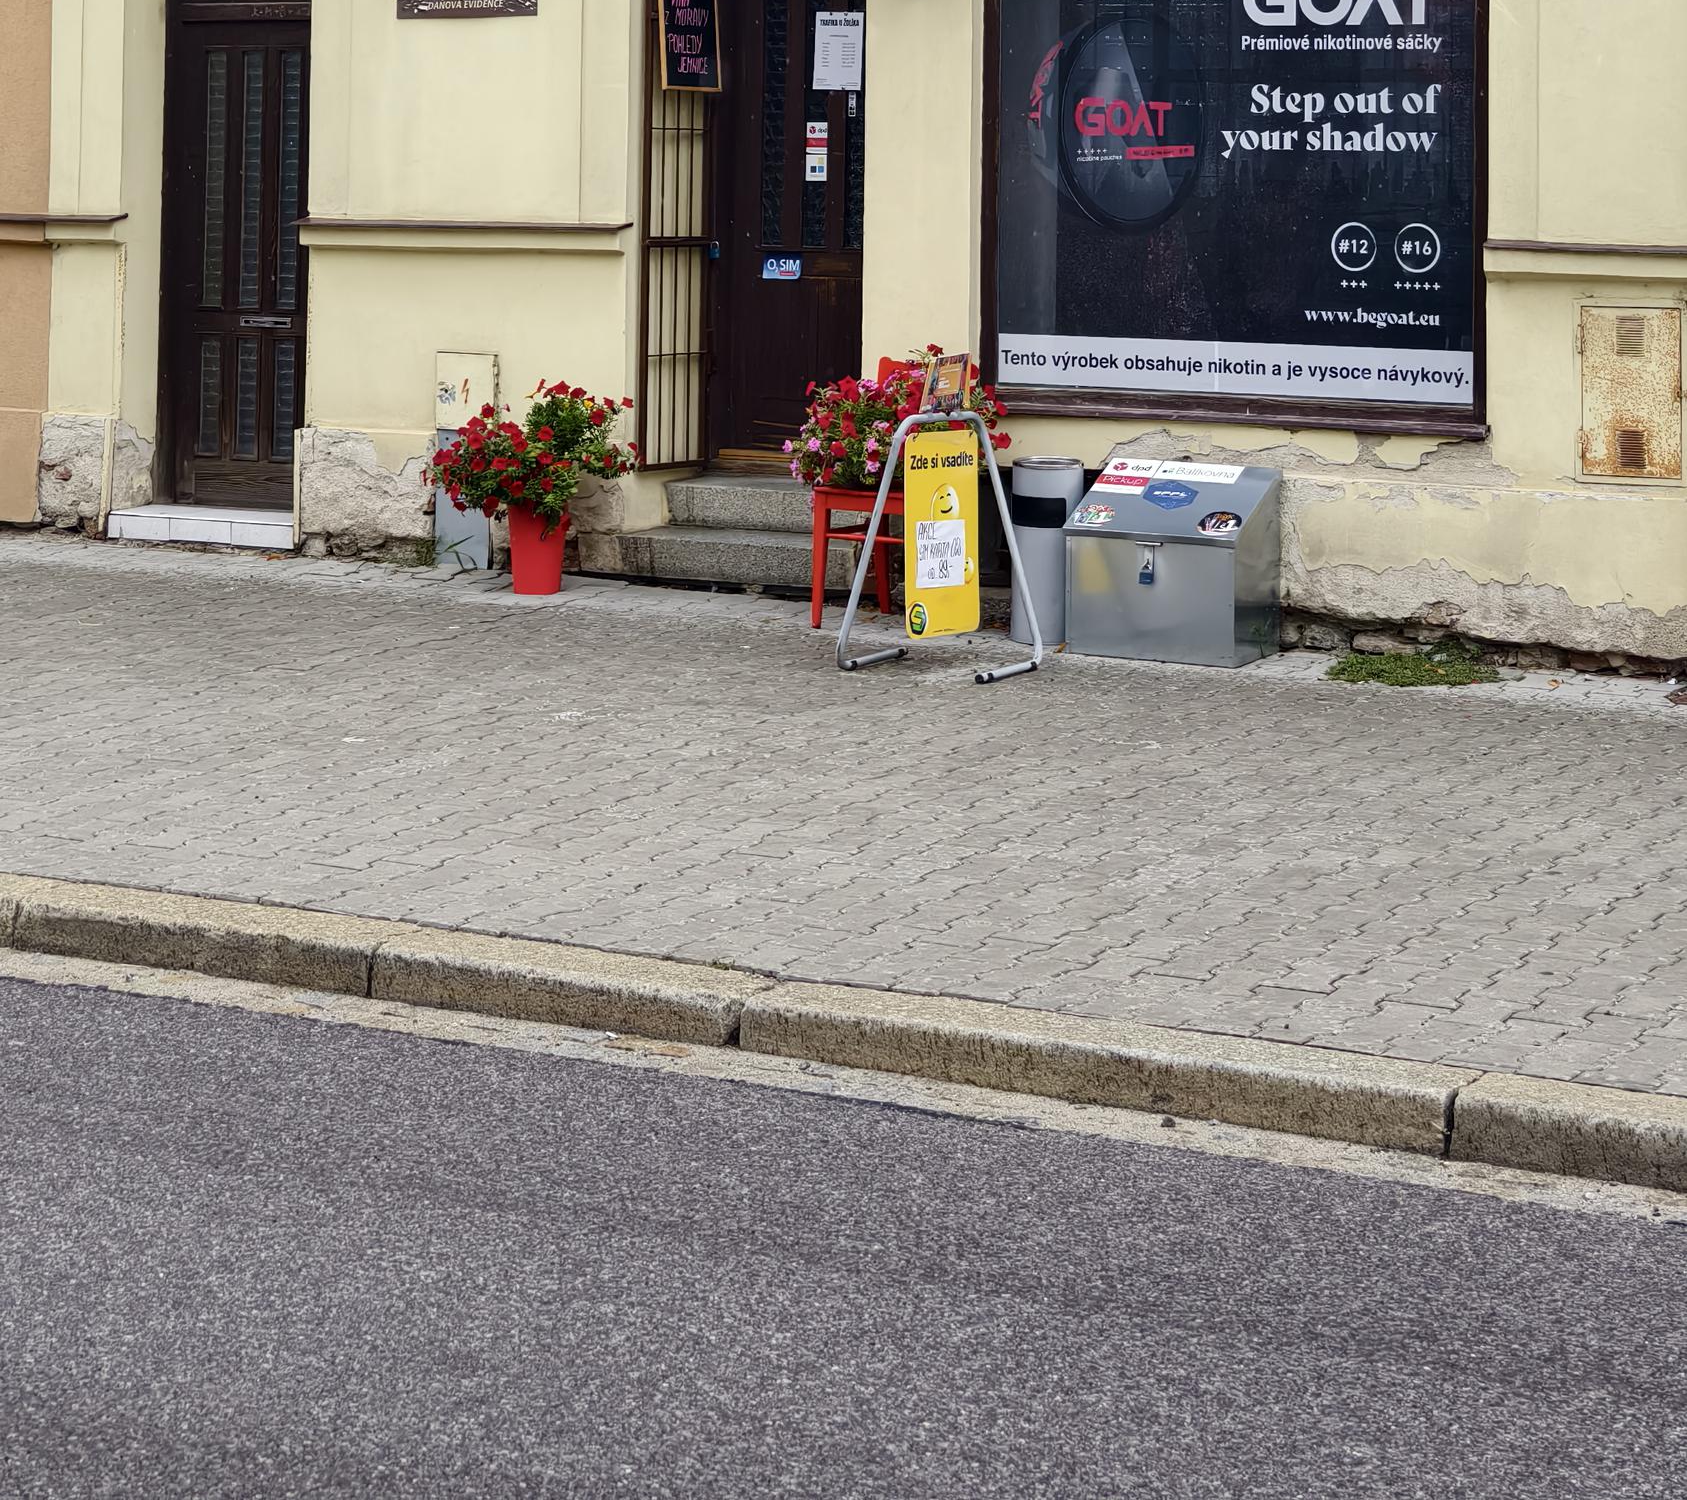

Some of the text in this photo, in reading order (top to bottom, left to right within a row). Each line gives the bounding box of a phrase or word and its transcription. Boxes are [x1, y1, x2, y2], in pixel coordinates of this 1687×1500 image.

[463, 0, 504, 9] EVIDENCE
[674, 8, 710, 27] MORAVY
[667, 33, 703, 54] POHLEDY
[1241, 34, 1443, 53] Prémiové nikotinové sáčky
[677, 56, 709, 75] JEMNICE
[1250, 84, 1442, 123] Step out of
[1074, 97, 1173, 136] GOAT
[1221, 122, 1438, 159] your shadow
[1338, 239, 1432, 256] #12 #16
[779, 259, 800, 271] SIM
[1304, 307, 1441, 329] www.begoat.eu
[1001, 350, 1470, 388] Tento výrobek obsahuje nikotin a je vysoce návykový.
[910, 450, 974, 470] Zde si vsadíte
[1131, 464, 1152, 472] dpd
[1102, 474, 1144, 486] Pickup
[918, 522, 937, 541] AKCE
